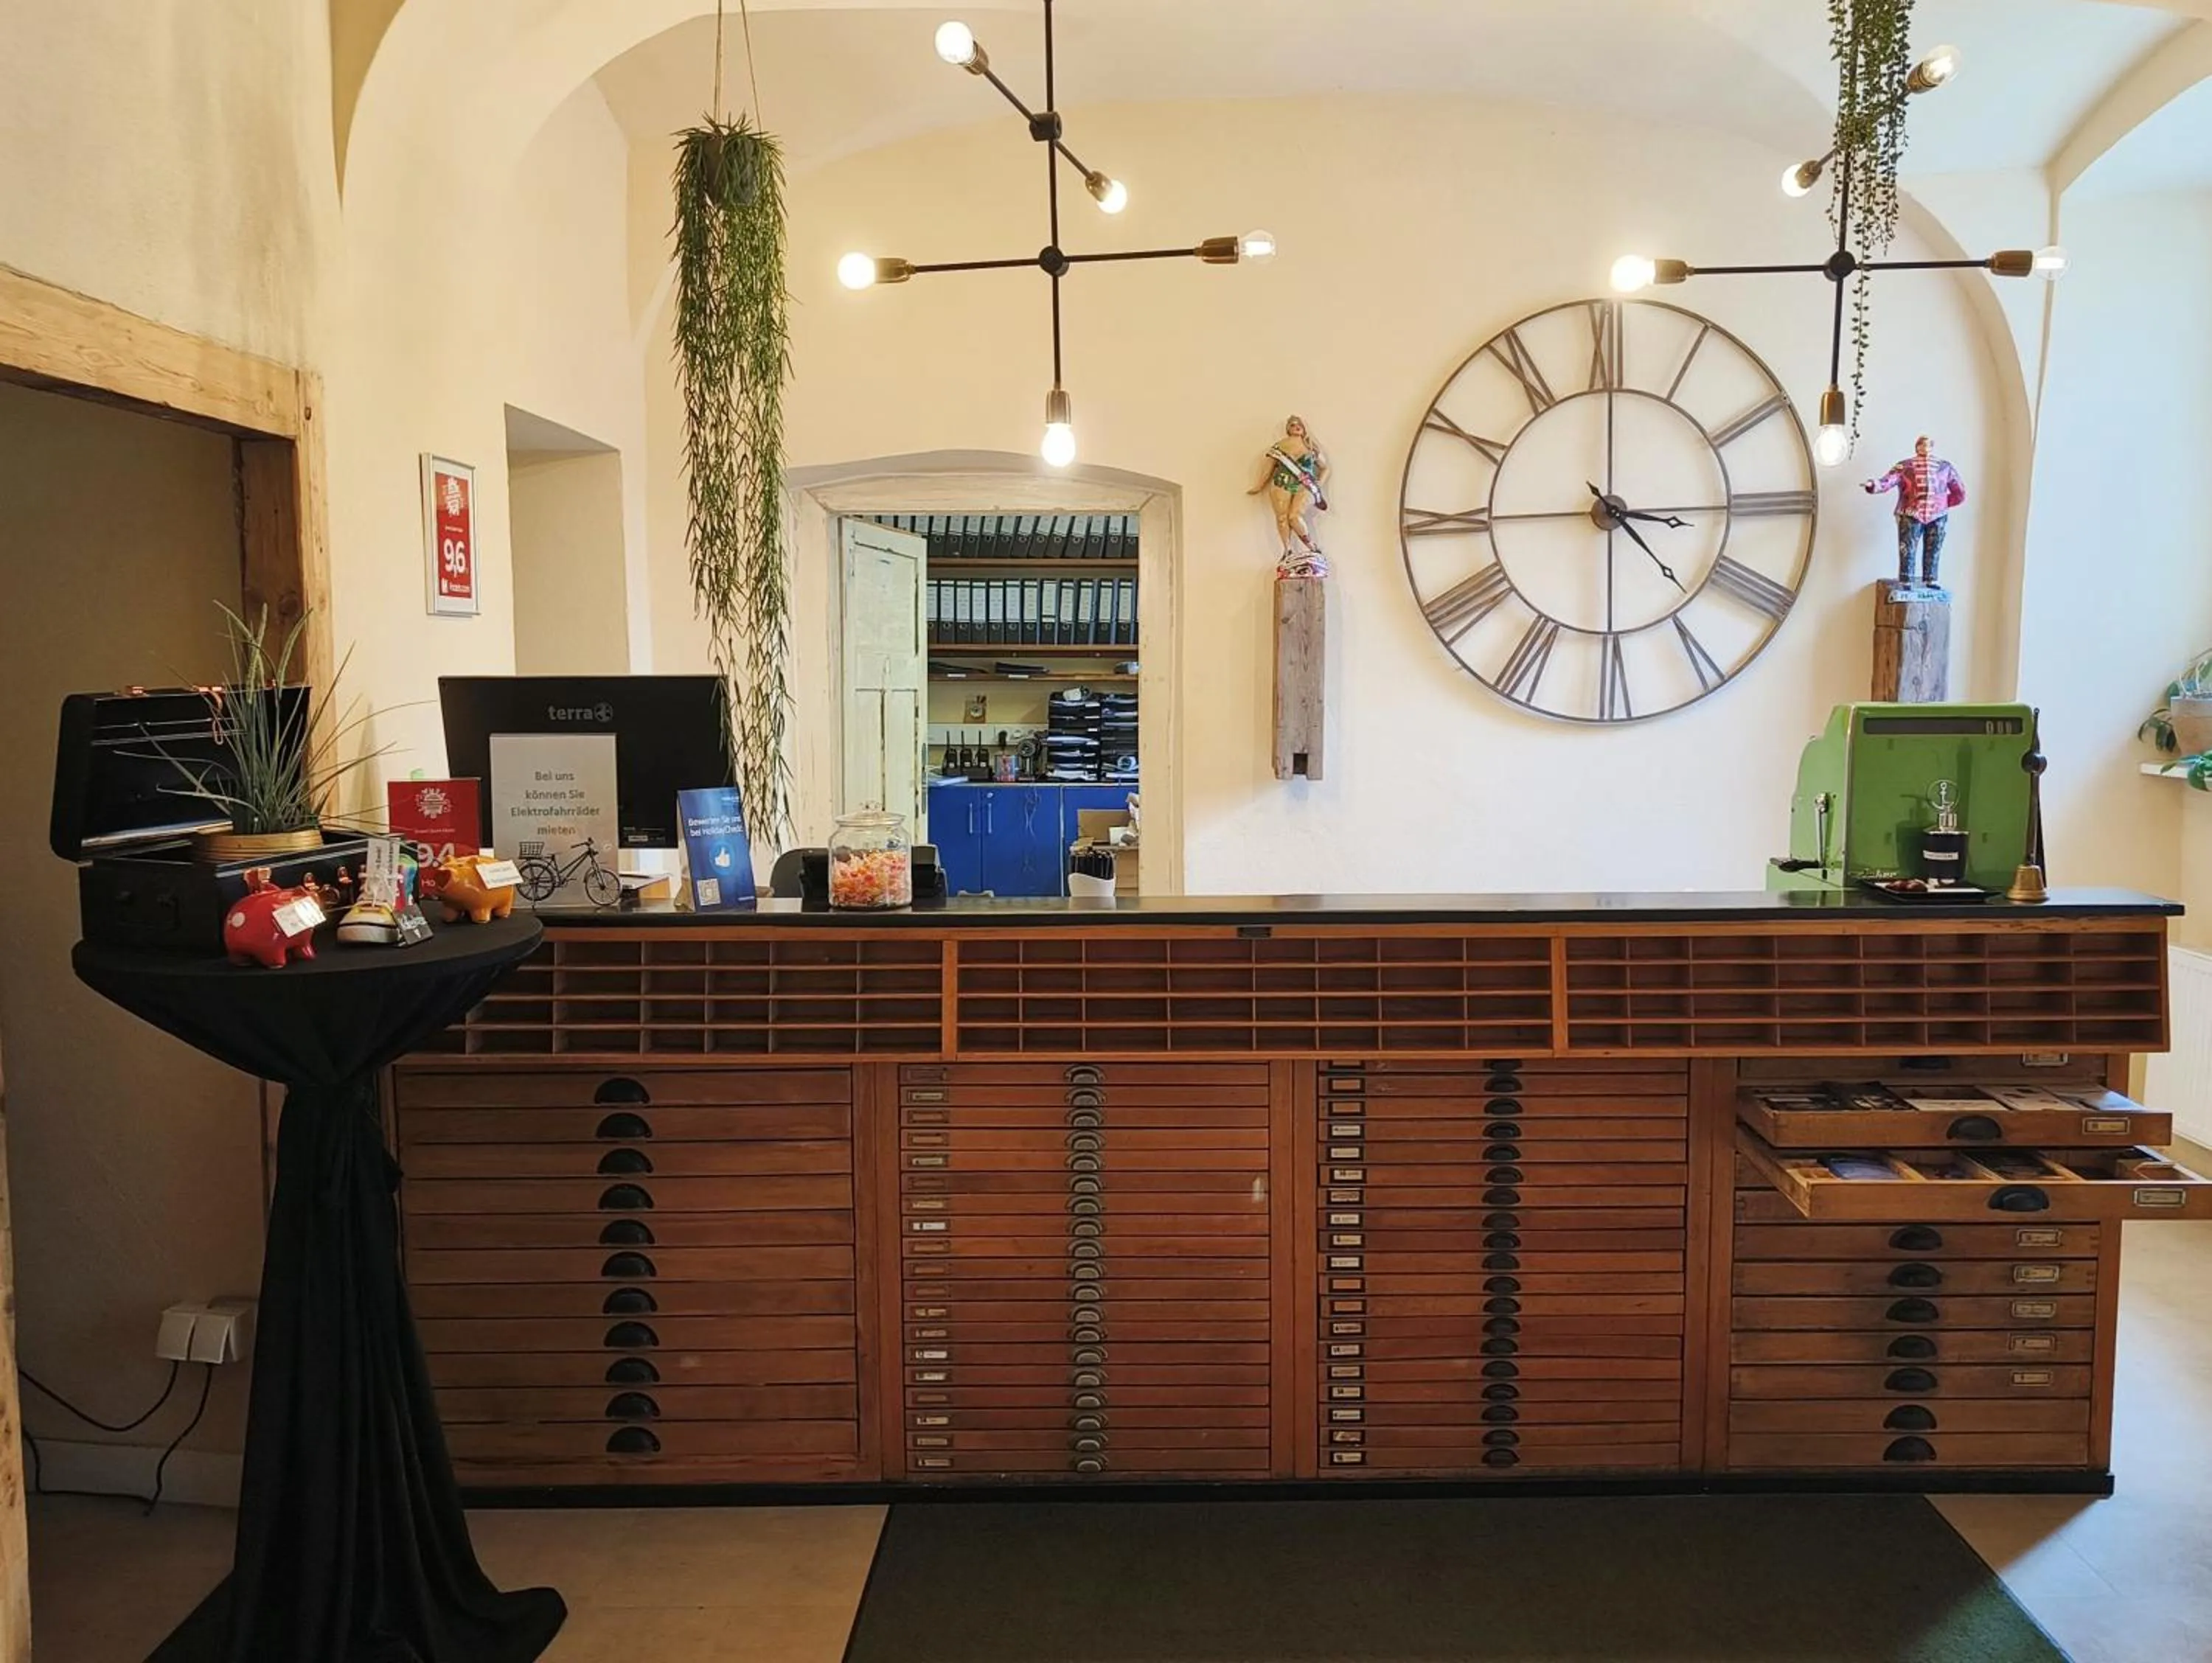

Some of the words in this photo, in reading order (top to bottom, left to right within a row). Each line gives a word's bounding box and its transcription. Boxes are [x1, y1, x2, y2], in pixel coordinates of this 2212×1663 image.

[548, 705, 594, 720] terra
[535, 771, 552, 781] Bei
[555, 772, 575, 781] uns
[525, 789, 566, 800] können
[568, 790, 585, 798] Sie
[510, 807, 600, 817] Elektrofahrräder
[537, 826, 576, 835] mieten
